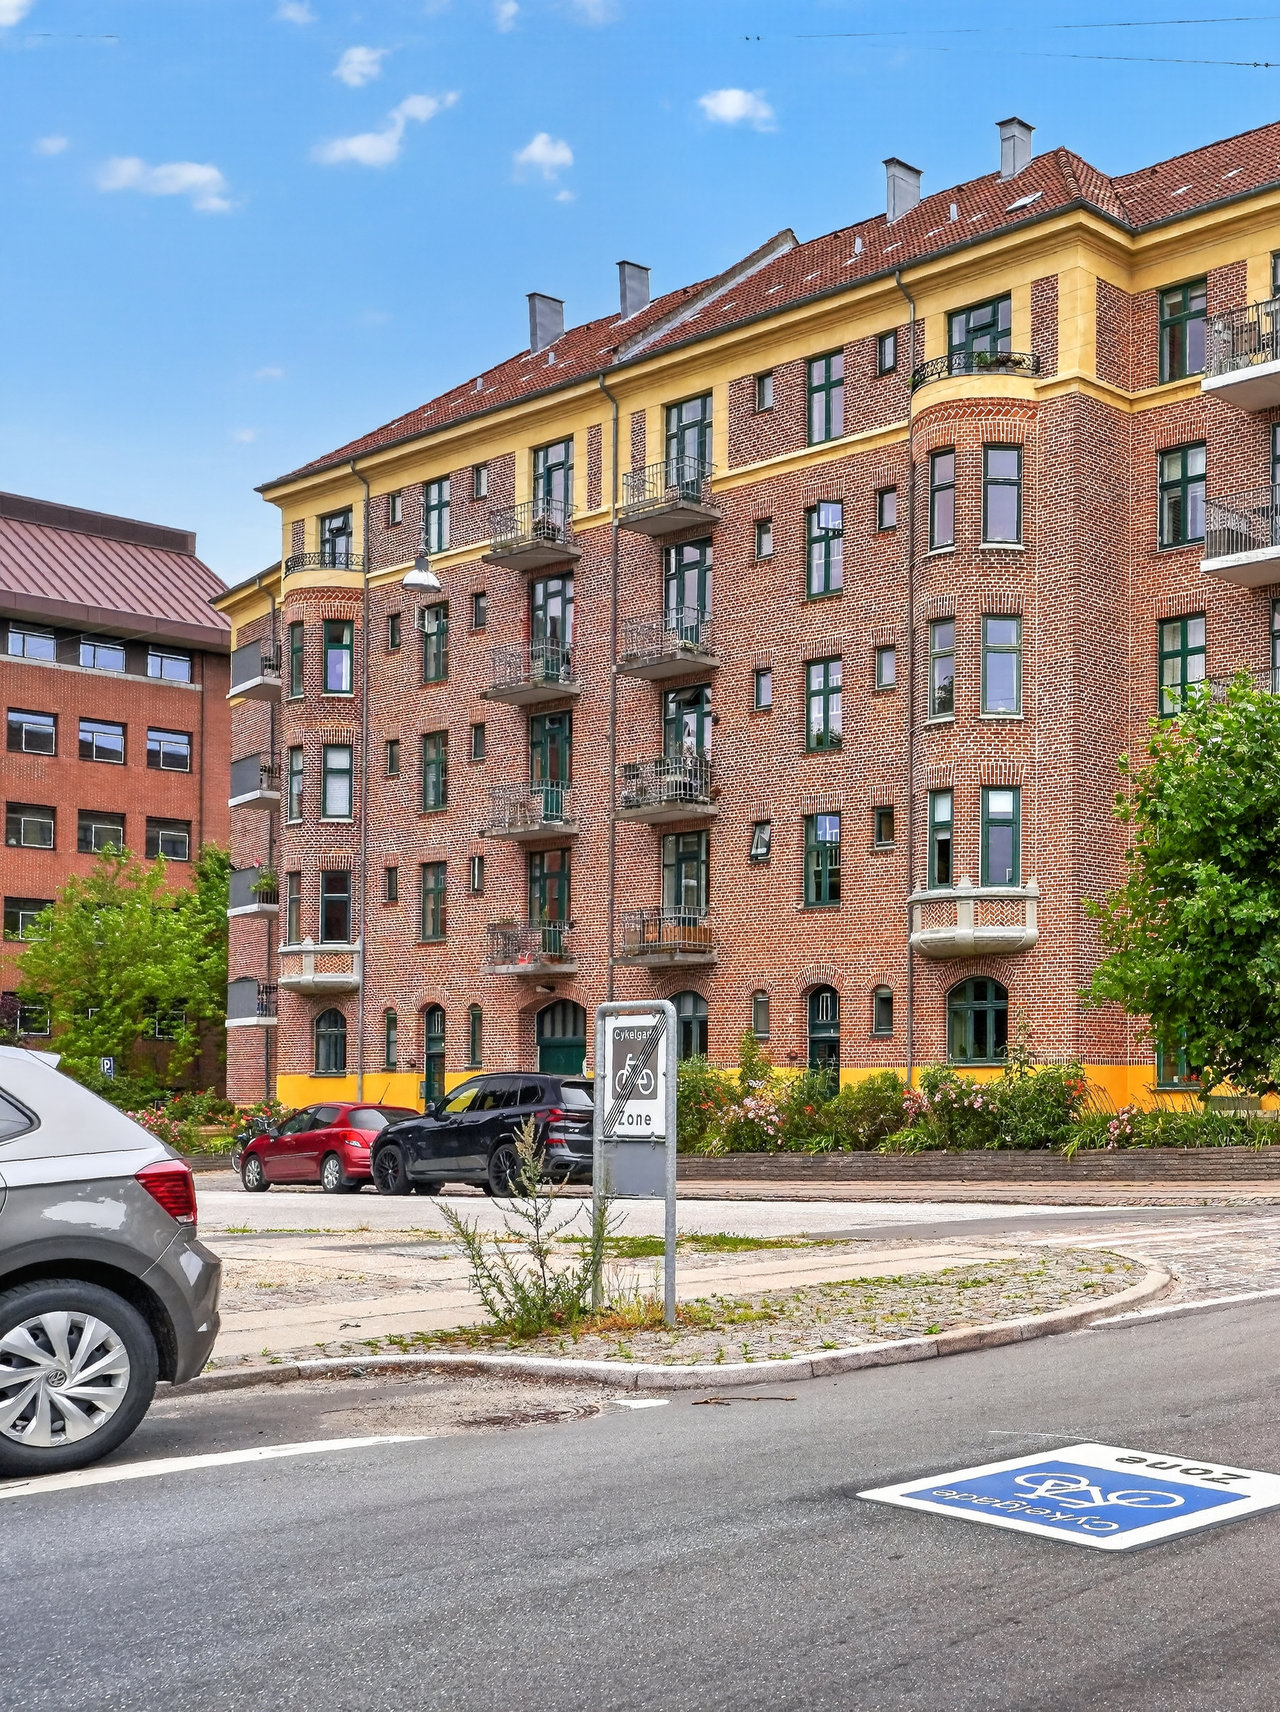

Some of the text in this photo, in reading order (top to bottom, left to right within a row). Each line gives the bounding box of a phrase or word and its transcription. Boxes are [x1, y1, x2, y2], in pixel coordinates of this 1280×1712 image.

[104, 1059, 111, 1073] P
[617, 1110, 652, 1126] Zone
[1115, 1455, 1251, 1485] Zone
[931, 1489, 1120, 1531] Cykelgade
